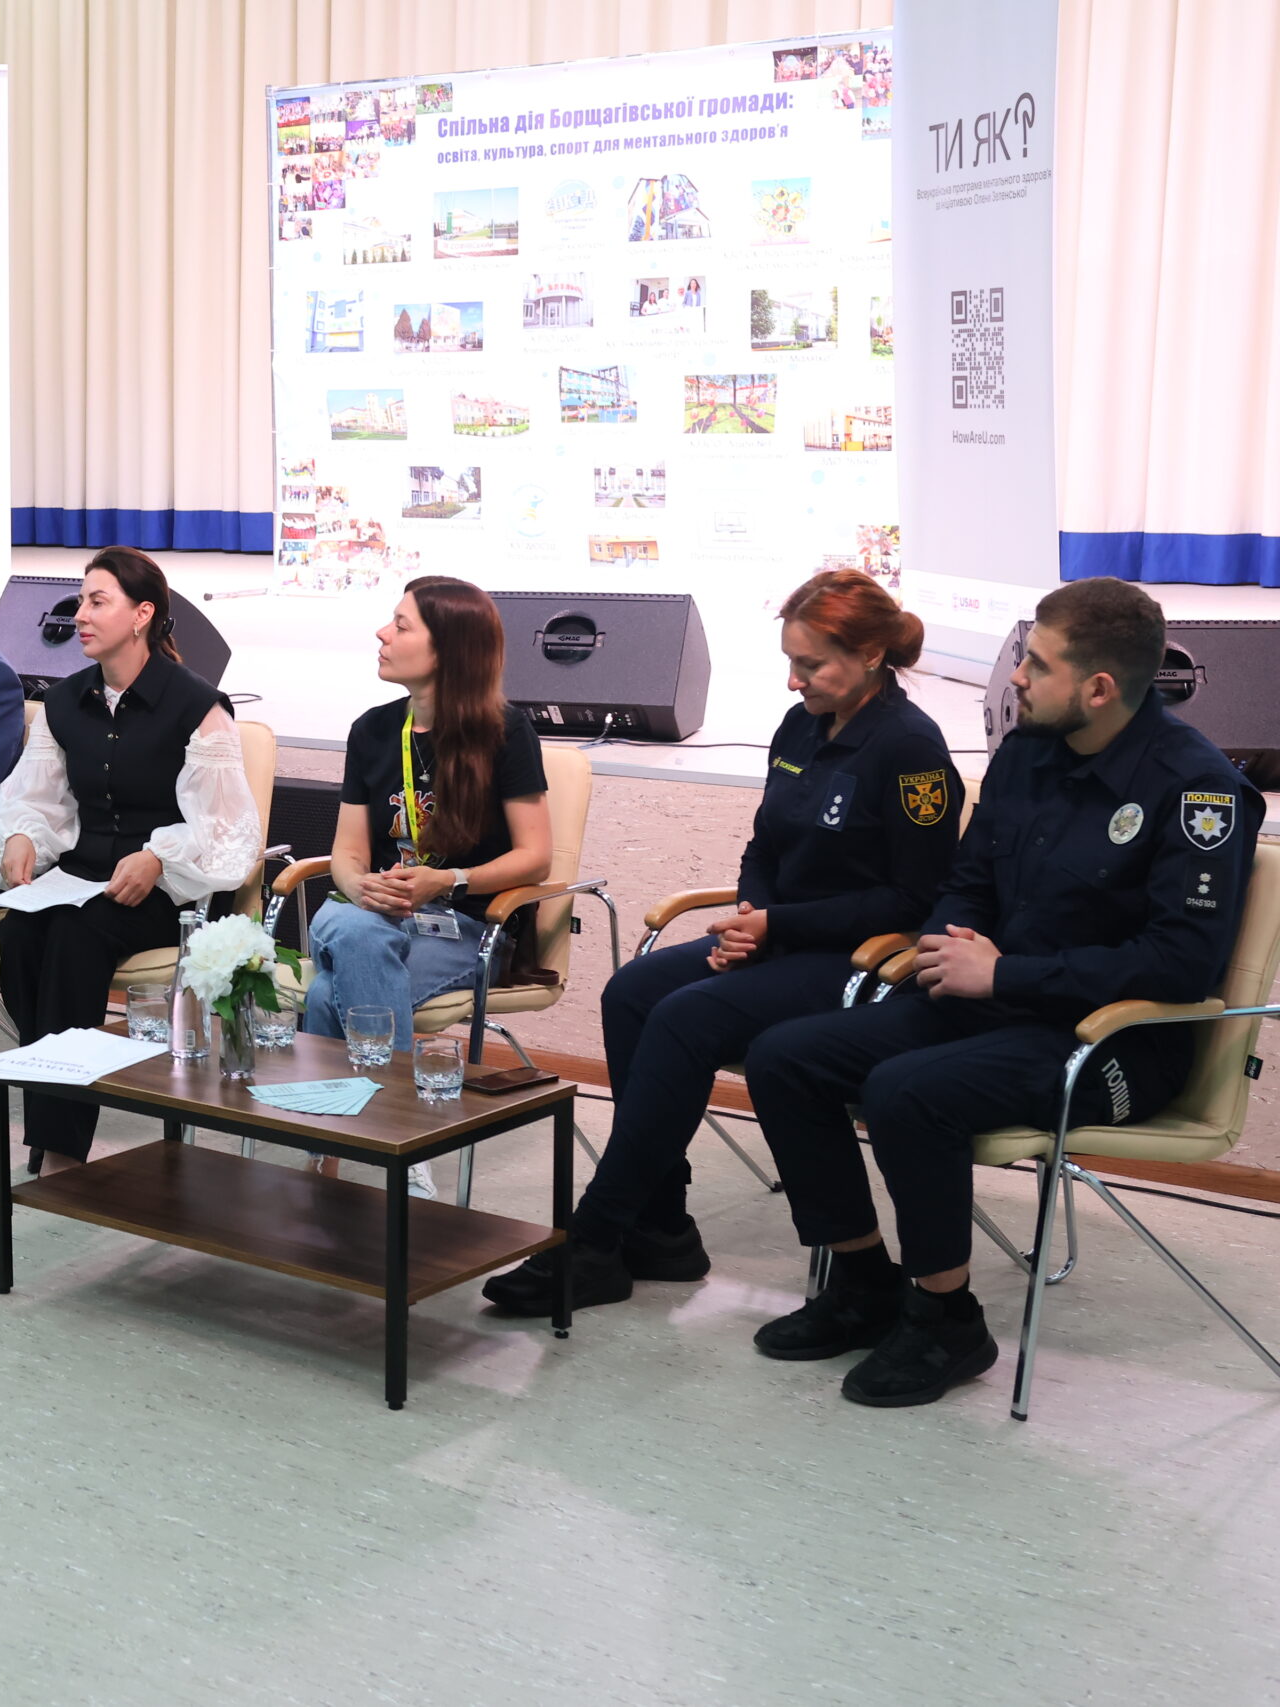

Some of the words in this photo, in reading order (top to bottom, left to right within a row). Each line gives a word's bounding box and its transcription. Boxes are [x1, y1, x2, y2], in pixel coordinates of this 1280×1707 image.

[438, 115, 510, 138] Спільна
[515, 110, 545, 135] дія
[550, 96, 693, 130] Борщагівської
[699, 91, 794, 119] громади:
[437, 148, 481, 164] освіта,
[484, 144, 547, 162] культура,
[550, 140, 590, 156] спорт
[593, 138, 620, 153] для
[623, 131, 717, 150] ментального
[928, 118, 963, 174] ТИ
[951, 429, 1006, 445] HowAreU.com
[959, 597, 980, 609] USAID
[1186, 793, 1231, 805] ПОЛІЦІЯ
[1101, 1057, 1131, 1124] ПОЛІЦІЯ
